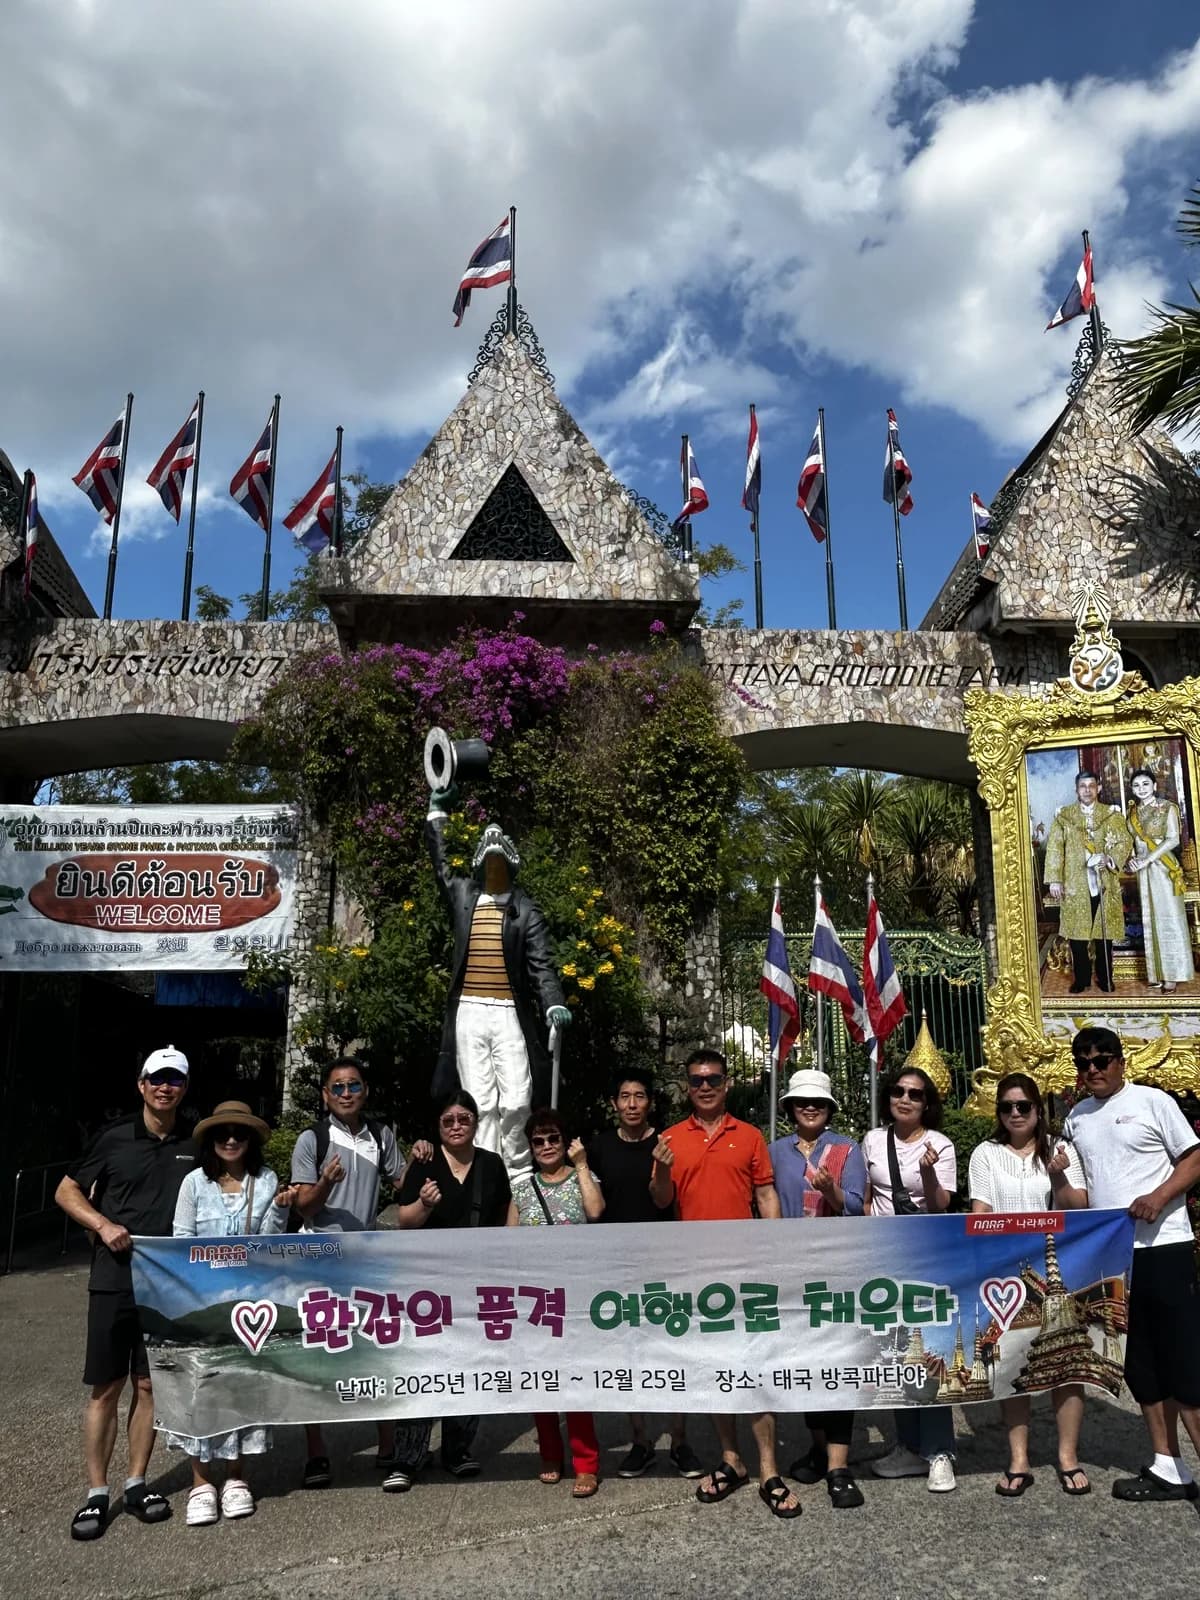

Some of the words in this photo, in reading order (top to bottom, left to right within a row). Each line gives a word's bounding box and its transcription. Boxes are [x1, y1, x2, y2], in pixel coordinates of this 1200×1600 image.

[809, 664, 950, 687] CROCODILE
[956, 665, 1025, 687] FARM
[56, 860, 264, 898] ยินดีต้อนรับ
[96, 905, 221, 925] WELCOME
[973, 1220, 1004, 1229] NARA
[1016, 1218, 1057, 1229] 나라투어
[190, 1244, 248, 1263] NARA
[267, 1242, 344, 1259] 나라투어
[301, 1289, 453, 1349] 환갑의
[476, 1286, 566, 1341] 품격
[590, 1282, 781, 1338] 여행으로
[803, 1278, 955, 1331] 채우다
[338, 1379, 386, 1401] 날짜:
[394, 1373, 465, 1395] 2025년
[472, 1371, 513, 1393] 12월
[520, 1370, 560, 1392] 21일
[593, 1369, 633, 1391] 12월
[641, 1369, 686, 1391] 25일
[716, 1370, 763, 1392] 장소:
[773, 1368, 813, 1391] 태국
[821, 1365, 927, 1390] 방콕파타야
